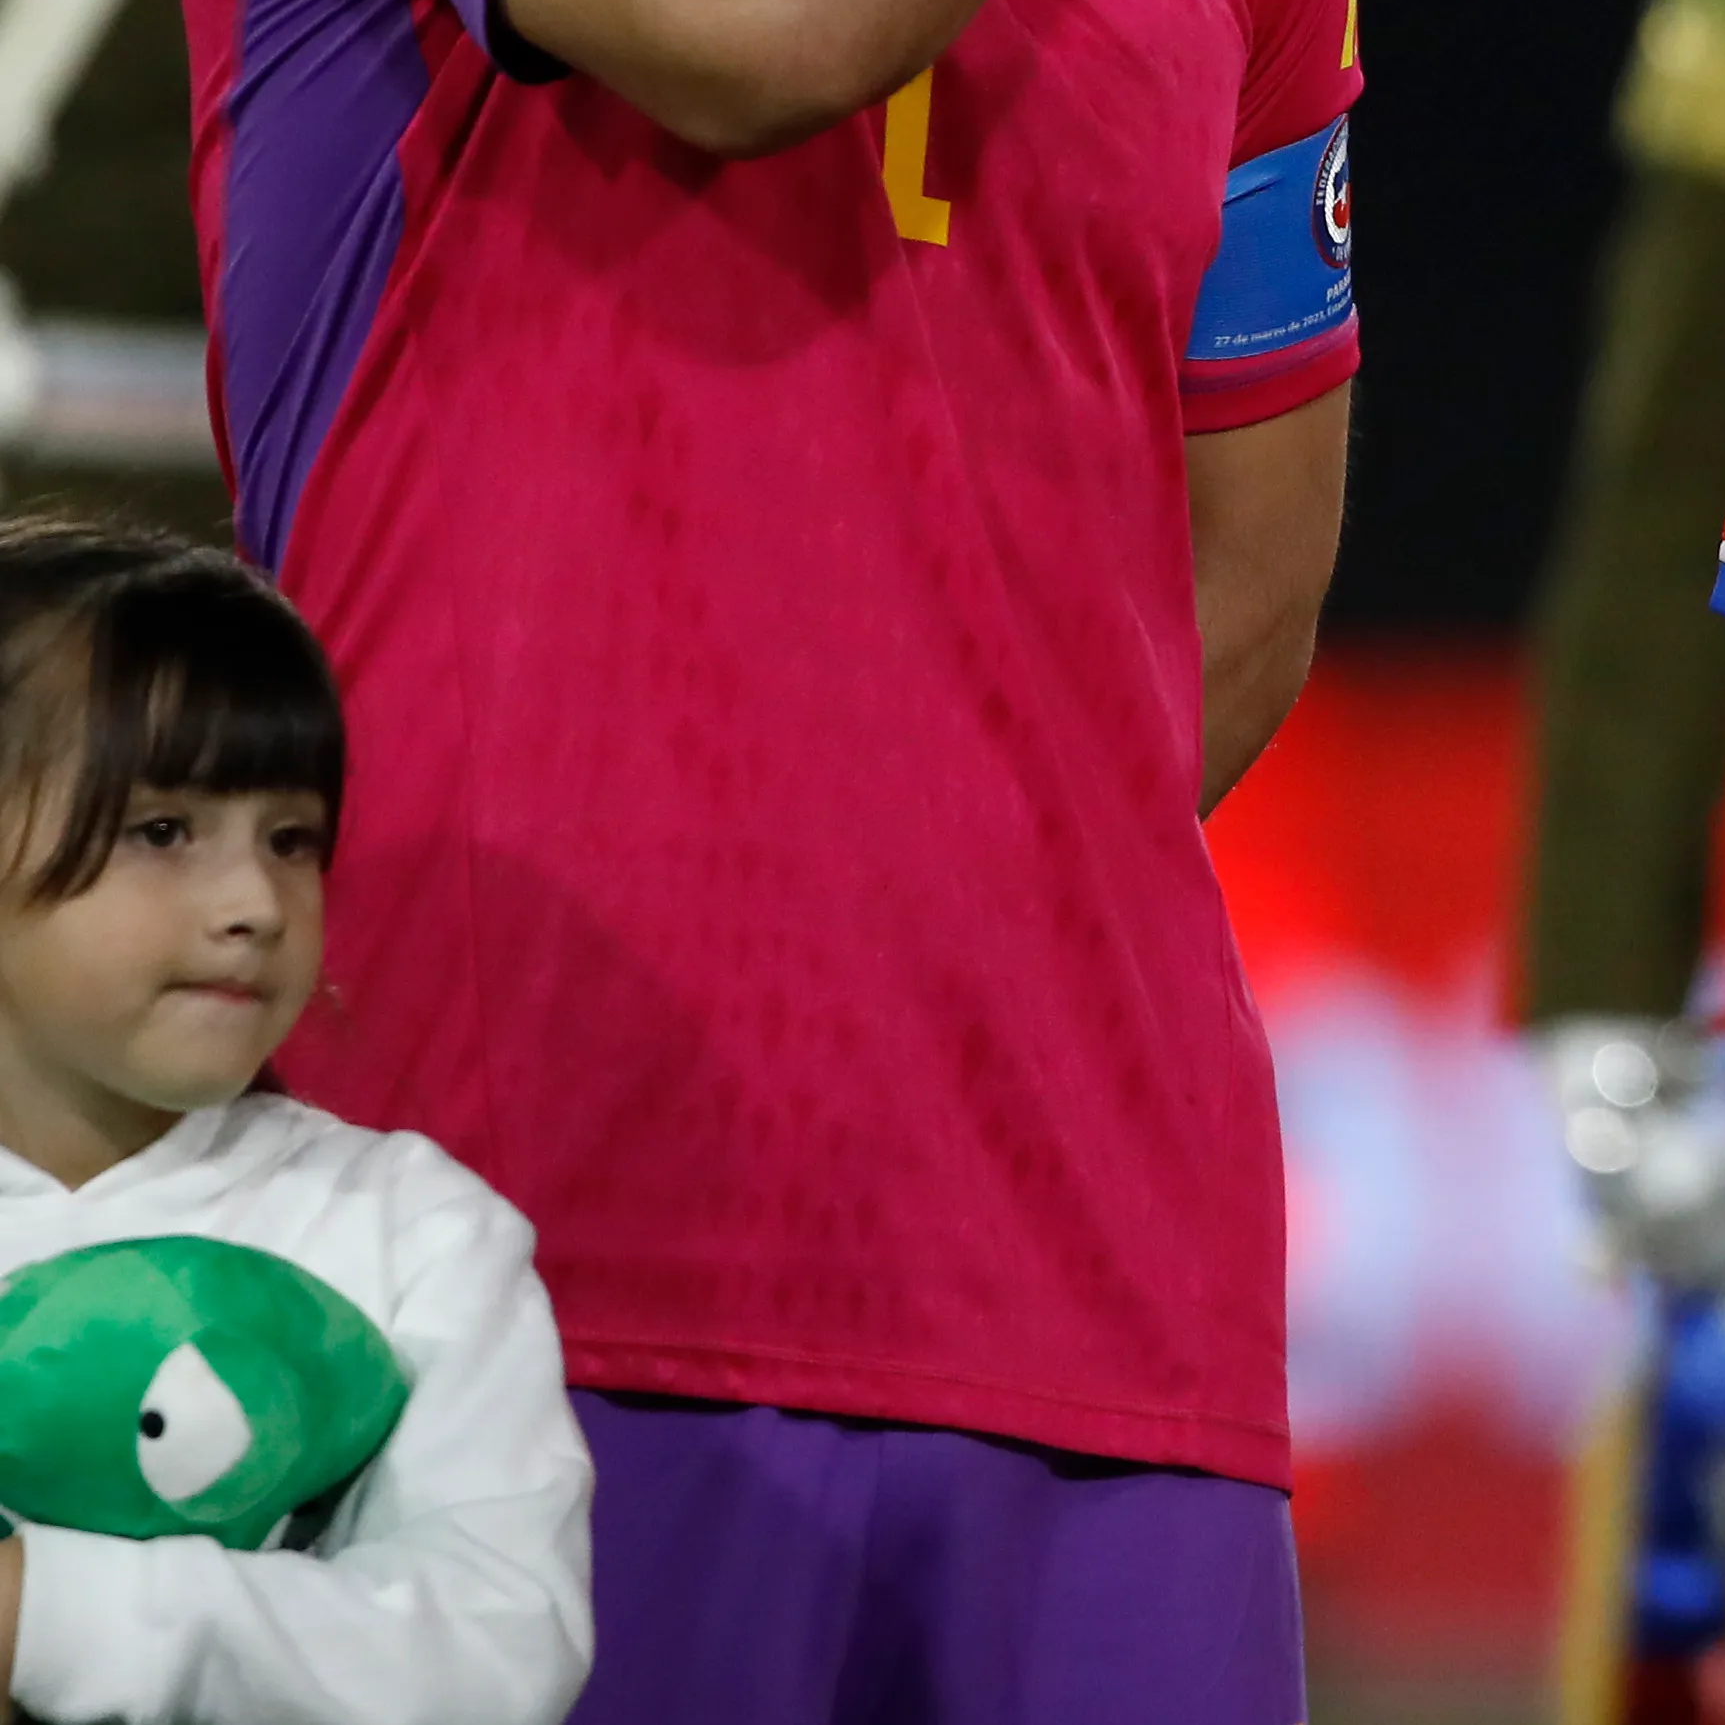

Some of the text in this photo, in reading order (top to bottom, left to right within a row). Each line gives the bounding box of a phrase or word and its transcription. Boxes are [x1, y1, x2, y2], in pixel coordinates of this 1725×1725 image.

[1214, 336, 1231, 348] 27
[1232, 334, 1249, 345] de
[1287, 321, 1301, 332] de
